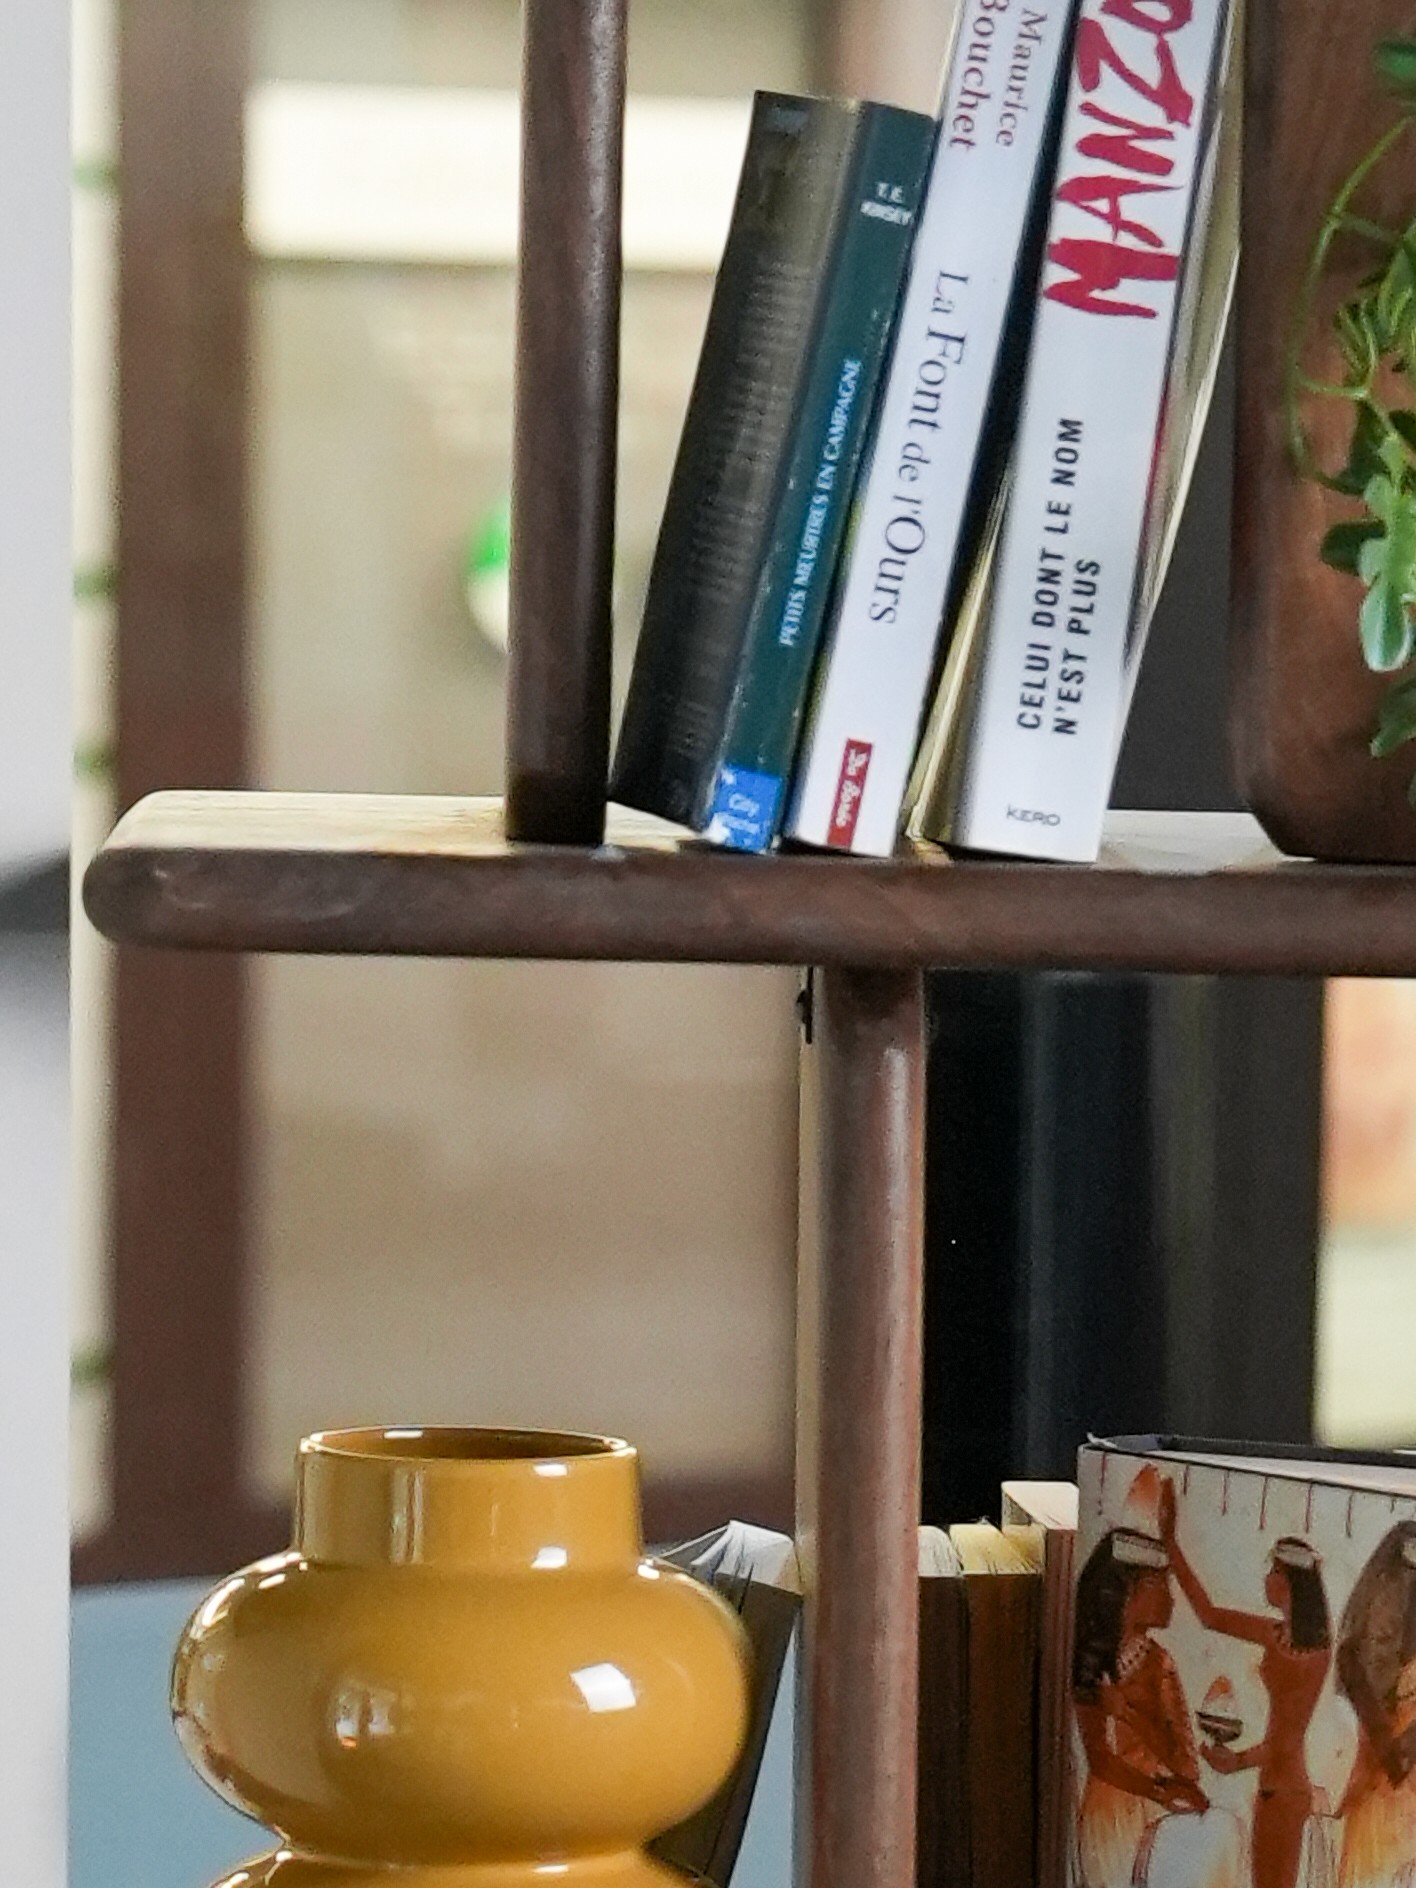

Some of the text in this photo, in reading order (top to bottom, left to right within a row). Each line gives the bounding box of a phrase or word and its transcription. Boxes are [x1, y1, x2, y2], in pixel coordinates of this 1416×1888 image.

[996, 8, 1048, 147] Maurice
[824, 358, 862, 462] CAMPAGNE
[869, 269, 970, 625] La Font de l'Ours
[1017, 418, 1084, 730] CELUI DONT LE NOM
[1053, 558, 1101, 736] N'EST PLUS
[1006, 804, 1061, 828] KERO
